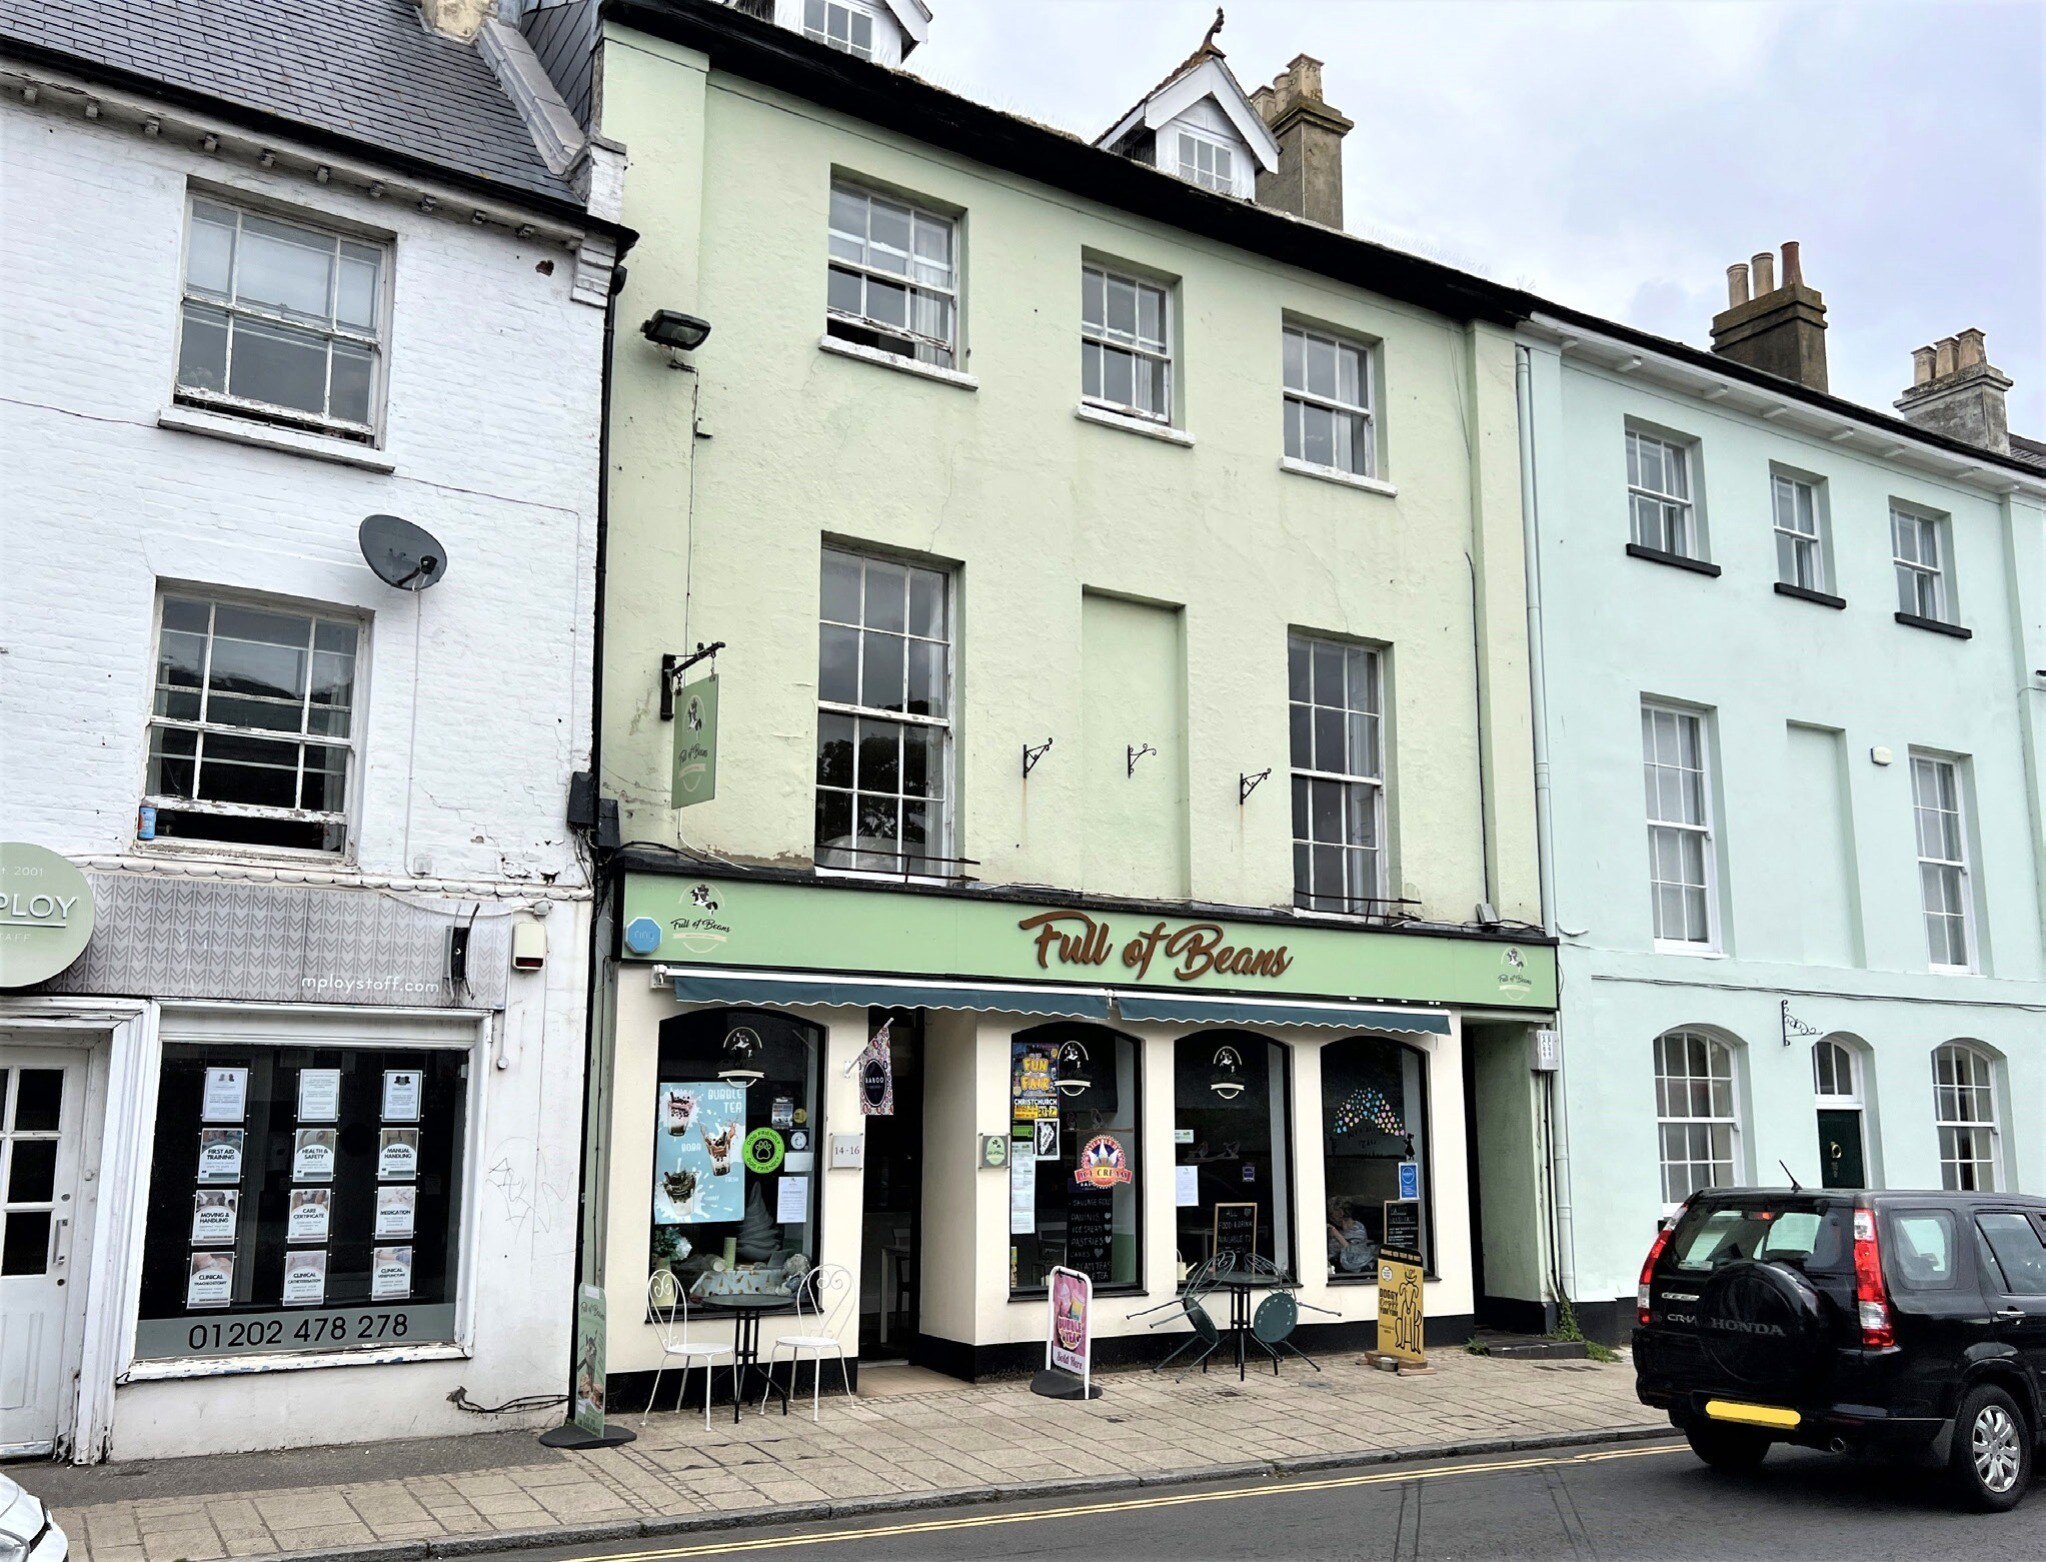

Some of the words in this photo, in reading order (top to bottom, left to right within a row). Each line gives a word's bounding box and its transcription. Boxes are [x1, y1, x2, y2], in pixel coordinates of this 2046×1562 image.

[14, 866, 44, 876] 2001
[670, 918, 690, 930] Full
[692, 918, 702, 930] of
[701, 918, 731, 933] Beans
[1018, 910, 1114, 970] Full
[1121, 921, 1172, 981] of
[1165, 923, 1294, 981] Beans
[301, 974, 439, 994] mploystaff.com
[1022, 1058, 1048, 1073] FUN
[1021, 1076, 1050, 1091] FAIR
[707, 1088, 743, 1101] BUBBLE
[723, 1101, 743, 1113] TEA
[188, 1319, 284, 1350] 01202
[293, 1316, 347, 1343] 478
[357, 1313, 409, 1339] 278
[1710, 1317, 1786, 1337] HONDA
